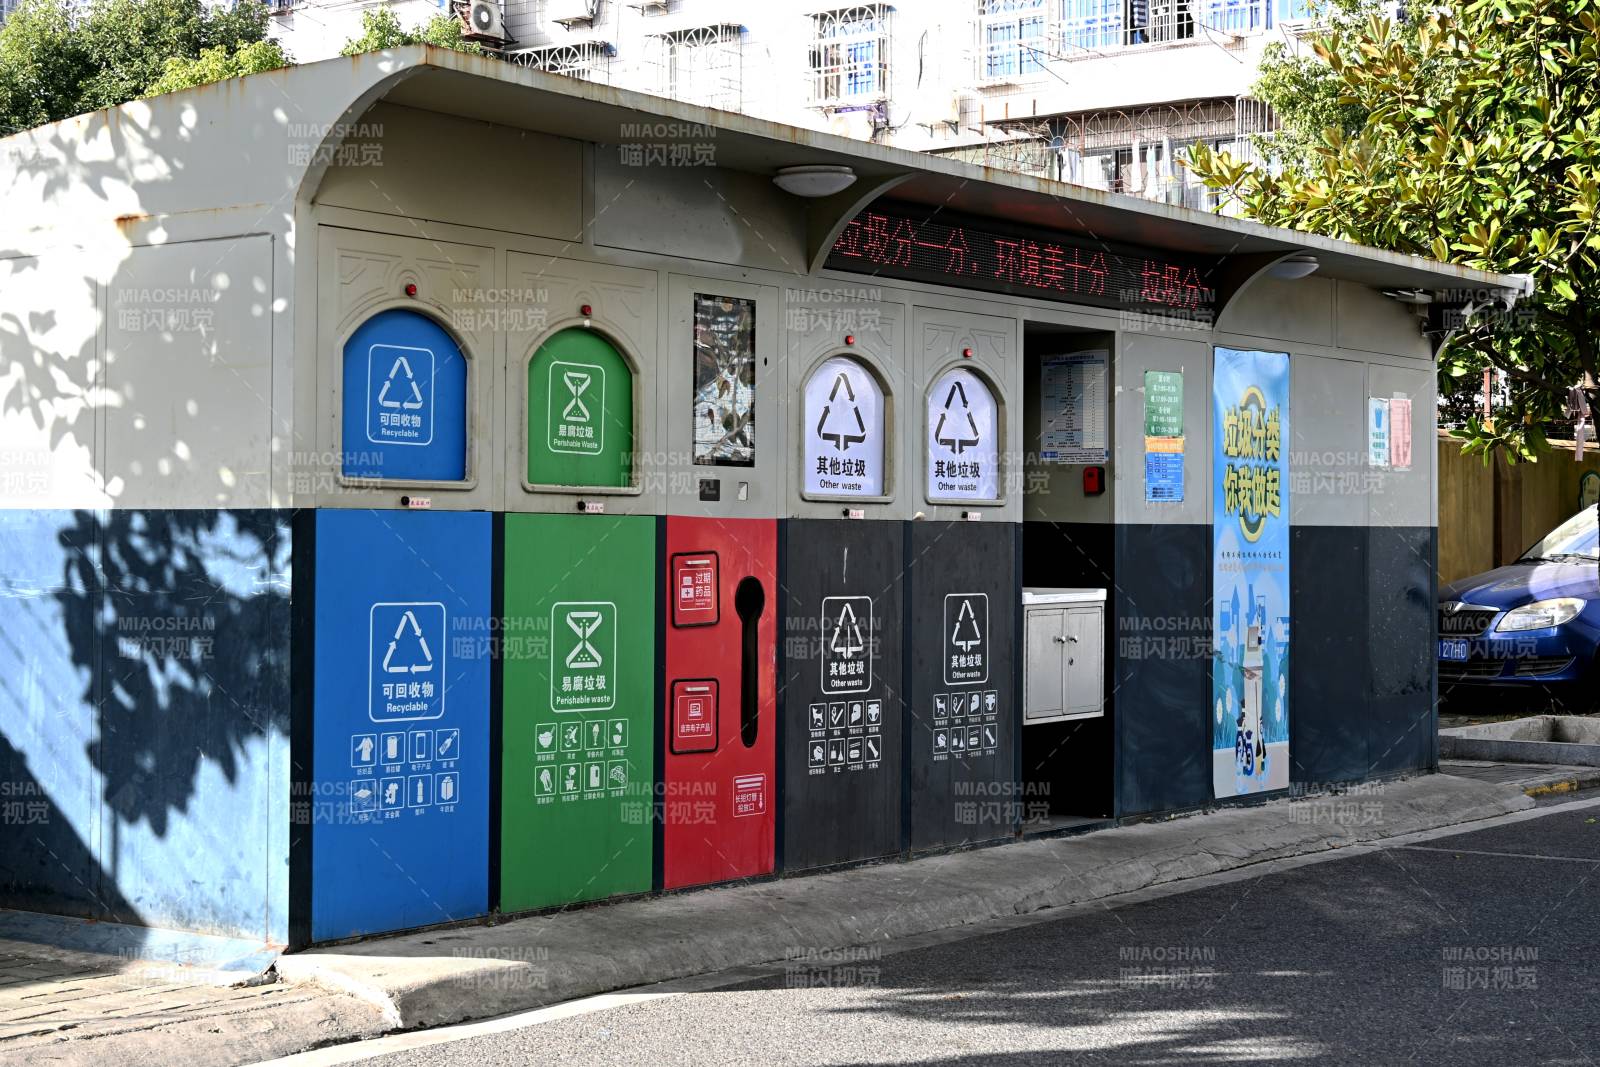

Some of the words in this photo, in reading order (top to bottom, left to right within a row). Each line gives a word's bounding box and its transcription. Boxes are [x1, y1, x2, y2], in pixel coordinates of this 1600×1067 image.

[379, 412, 421, 427] 可回收物
[381, 428, 419, 438] Recyclable
[558, 424, 594, 439] 易腐垃圾
[1223, 404, 1281, 461] 垃圾分类
[553, 438, 581, 449] Perishable
[581, 440, 598, 449] Waste
[816, 455, 866, 477] 其他垃圾
[934, 459, 981, 479] 其他垃圾
[819, 478, 839, 489] Other
[841, 481, 862, 491] waste
[937, 481, 956, 491] Other
[957, 483, 977, 491] waste
[1223, 464, 1281, 518] 你我做起
[695, 572, 711, 584] 过期
[695, 585, 711, 597] 药品
[951, 653, 982, 668] 其他垃圾
[829, 660, 865, 676] 其他垃圾
[952, 671, 966, 679] Other
[966, 670, 981, 678] waste
[562, 675, 606, 692] 易腐垃圾
[830, 678, 847, 688] Other
[847, 678, 863, 687] waste
[382, 681, 434, 699] 可回收物
[556, 695, 590, 705] Perishable
[591, 694, 611, 703] waste
[386, 702, 429, 714] Recyclable
[411, 763, 432, 772] 电子产品
